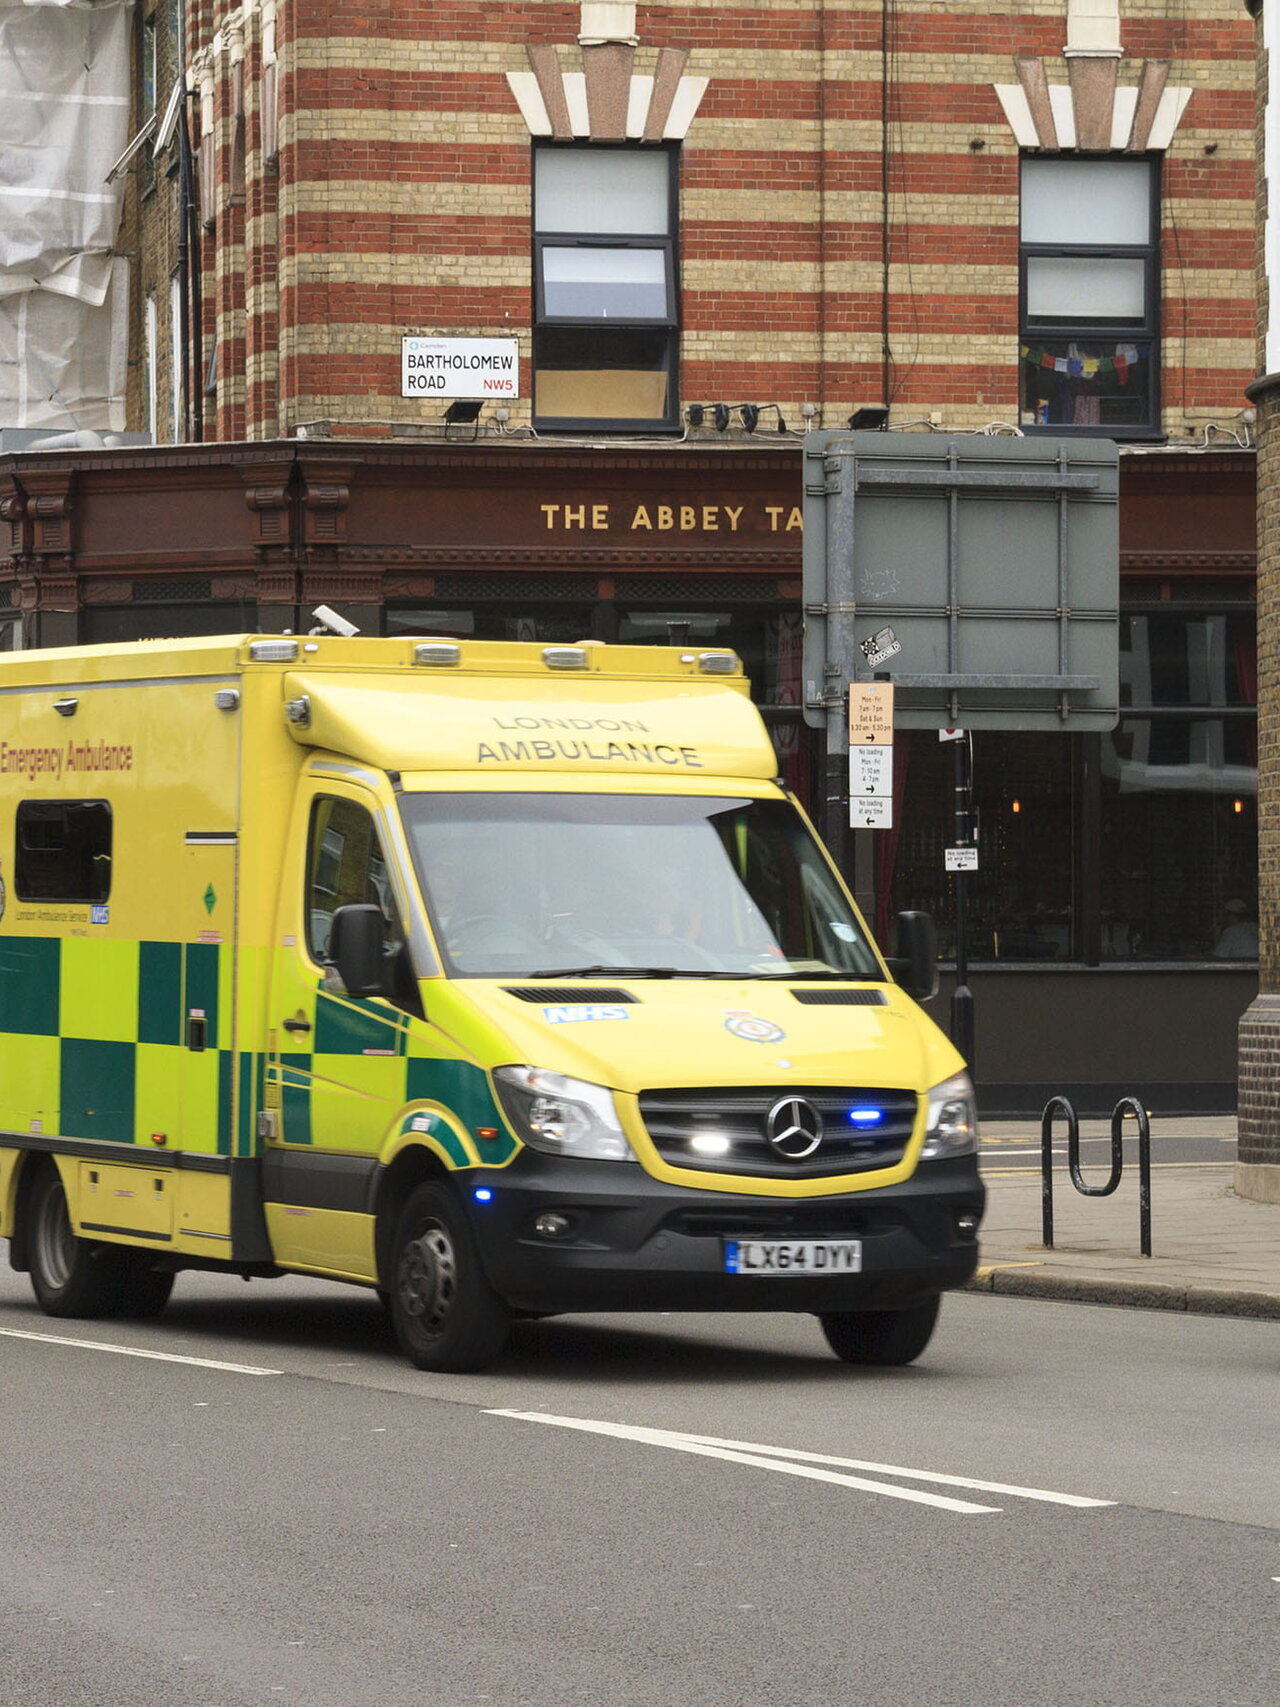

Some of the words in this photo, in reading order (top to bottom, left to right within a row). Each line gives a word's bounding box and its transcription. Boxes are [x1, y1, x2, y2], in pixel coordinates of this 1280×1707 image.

[420, 341, 448, 349] Camden
[407, 354, 514, 370] BARTHOLOMEW
[407, 375, 446, 390] ROAD
[483, 379, 513, 391] NW5
[540, 504, 610, 530] THE
[629, 505, 744, 532] ABBEY
[764, 507, 804, 532] TA
[492, 717, 650, 733] LONDON
[0, 740, 64, 781] Emergency
[64, 738, 132, 772] Ambulance
[477, 740, 704, 768] AMBULANCE
[866, 748, 883, 756] loading
[545, 1006, 629, 1024] NHS
[739, 1244, 806, 1269] LX64
[813, 1245, 857, 1269] DYV
